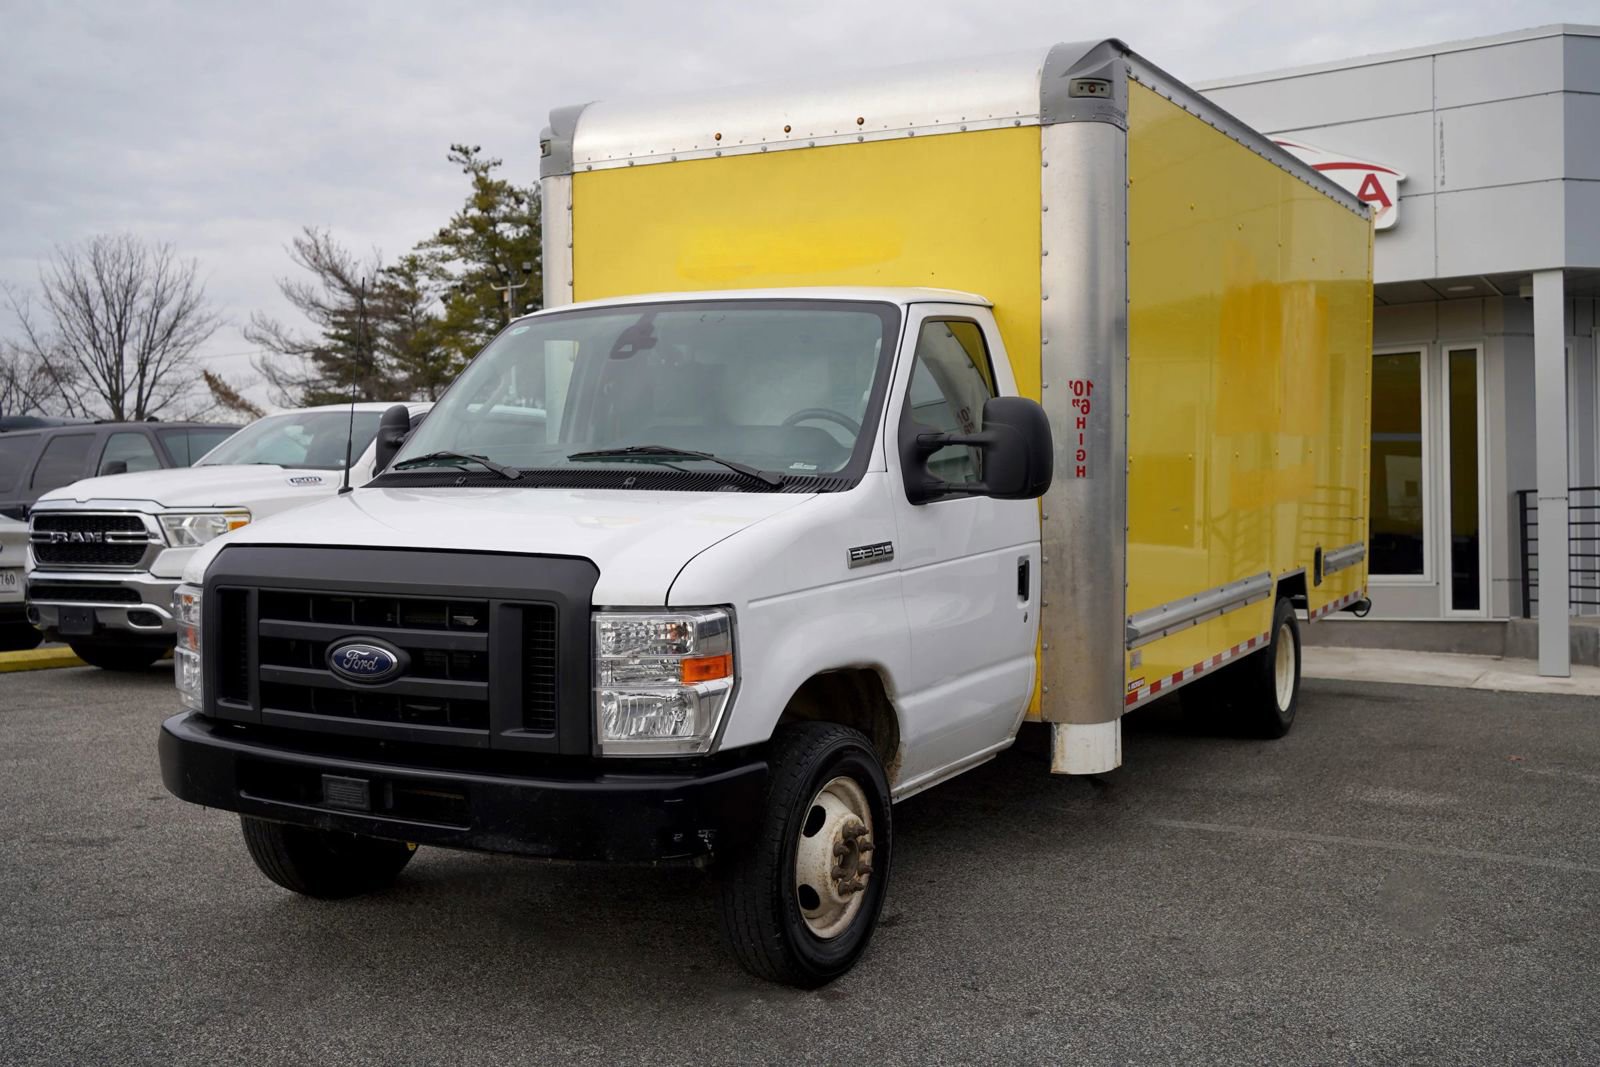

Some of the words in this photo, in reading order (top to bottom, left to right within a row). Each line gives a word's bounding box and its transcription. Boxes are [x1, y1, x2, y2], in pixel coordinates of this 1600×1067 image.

[1357, 173, 1392, 207] A
[55, 531, 102, 543] RAM
[343, 649, 379, 671] Ford
